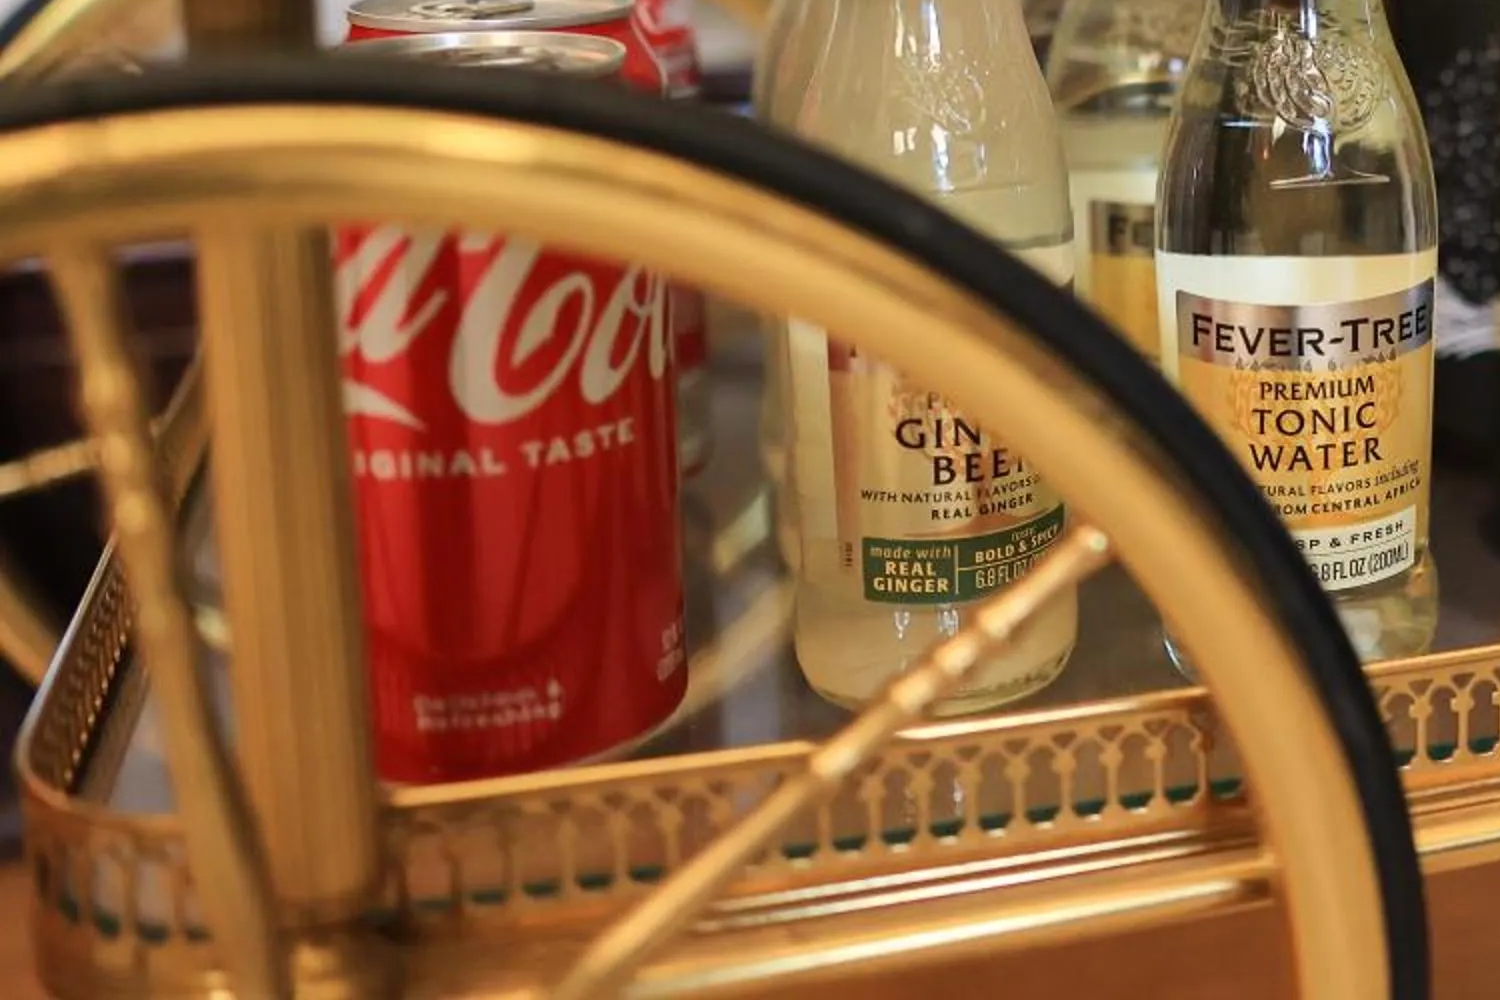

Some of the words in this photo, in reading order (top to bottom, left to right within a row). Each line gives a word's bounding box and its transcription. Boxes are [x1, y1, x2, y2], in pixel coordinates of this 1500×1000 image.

[1193, 304, 1428, 356] FEVER-TREE
[1259, 376, 1375, 400] PREMIUM
[1252, 402, 1377, 435] TONIC
[895, 418, 981, 449] GIN
[354, 446, 508, 481] IGINAL
[519, 417, 635, 468] TASTE
[1250, 437, 1383, 472] WATER
[861, 490, 897, 502] WITH
[901, 489, 971, 503] NATURAL
[1311, 477, 1371, 496] FLAVORS
[931, 509, 972, 520] REAL
[979, 494, 1033, 515] GINGER
[1311, 495, 1380, 514] CENTRAL
[1329, 537, 1341, 548] &
[1350, 519, 1404, 544] FRESH
[870, 545, 911, 558] made
[917, 544, 951, 558] with
[975, 545, 1015, 563] BOLD
[885, 561, 937, 576] REAL
[1333, 561, 1348, 580] FL
[1350, 557, 1366, 576] OZ
[873, 577, 950, 593] GINGER
